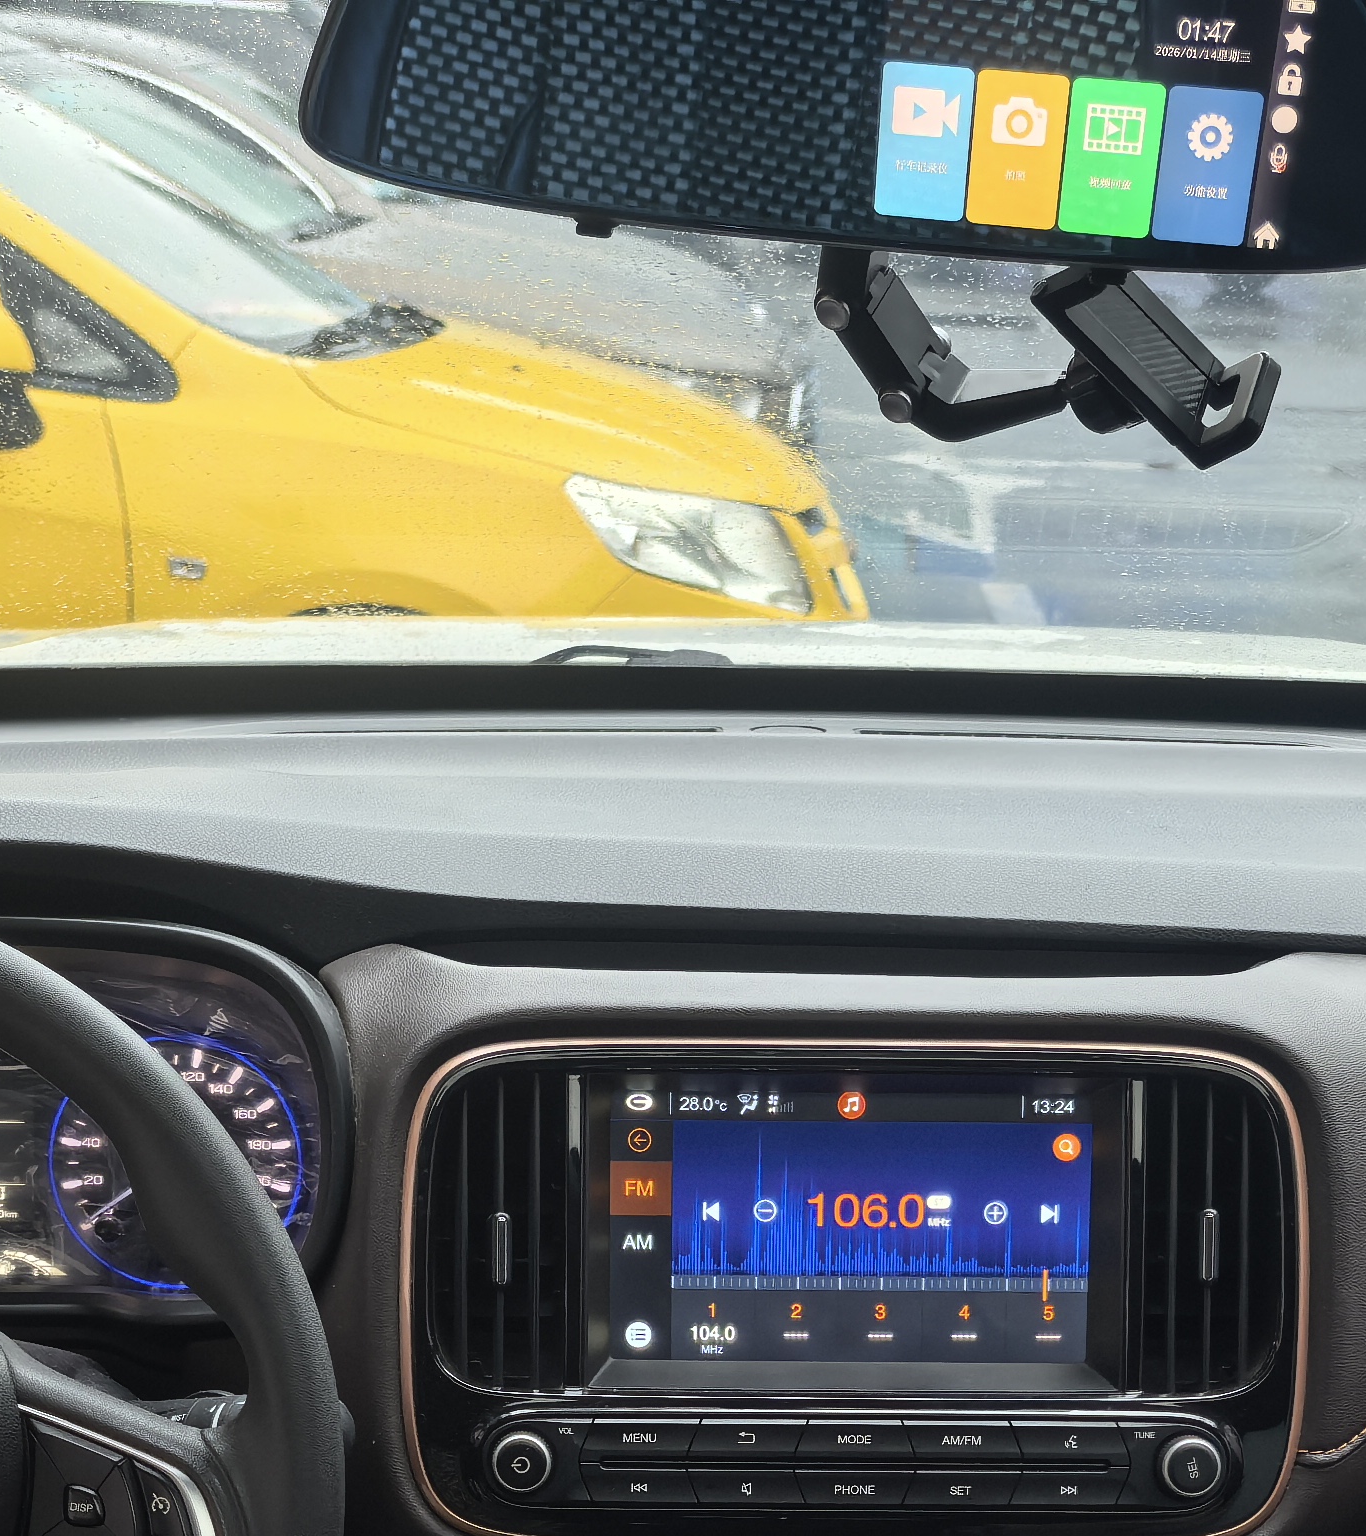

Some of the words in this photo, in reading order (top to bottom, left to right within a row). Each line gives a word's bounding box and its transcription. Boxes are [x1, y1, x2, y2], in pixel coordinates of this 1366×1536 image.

[1178, 19, 1236, 43] 01:47
[209, 1084, 233, 1094] 140
[1032, 1100, 1075, 1114] 13:24
[234, 1109, 257, 1119] 160
[82, 1138, 100, 1147] 40
[248, 1140, 271, 1150] 180
[84, 1175, 103, 1185] 20
[625, 1180, 654, 1197] FM
[807, 1192, 925, 1228] 106.0
[928, 1217, 951, 1227] MHz
[623, 1234, 653, 1250] AM
[708, 1303, 716, 1318] 1
[790, 1304, 802, 1318] 2
[874, 1304, 886, 1320] 3
[958, 1305, 970, 1320] 4
[1042, 1306, 1054, 1321] 5
[690, 1325, 735, 1341] 104.0
[701, 1345, 723, 1354] MHz
[558, 1427, 574, 1435] VOL
[1134, 1431, 1156, 1439] TUNE
[622, 1433, 657, 1443] MENU
[837, 1434, 872, 1445] MODE
[942, 1435, 982, 1446] AM/FM
[1188, 1457, 1199, 1479] SEL
[834, 1485, 875, 1495] PHONE
[949, 1486, 971, 1496] SET
[69, 1502, 94, 1513] DISP
